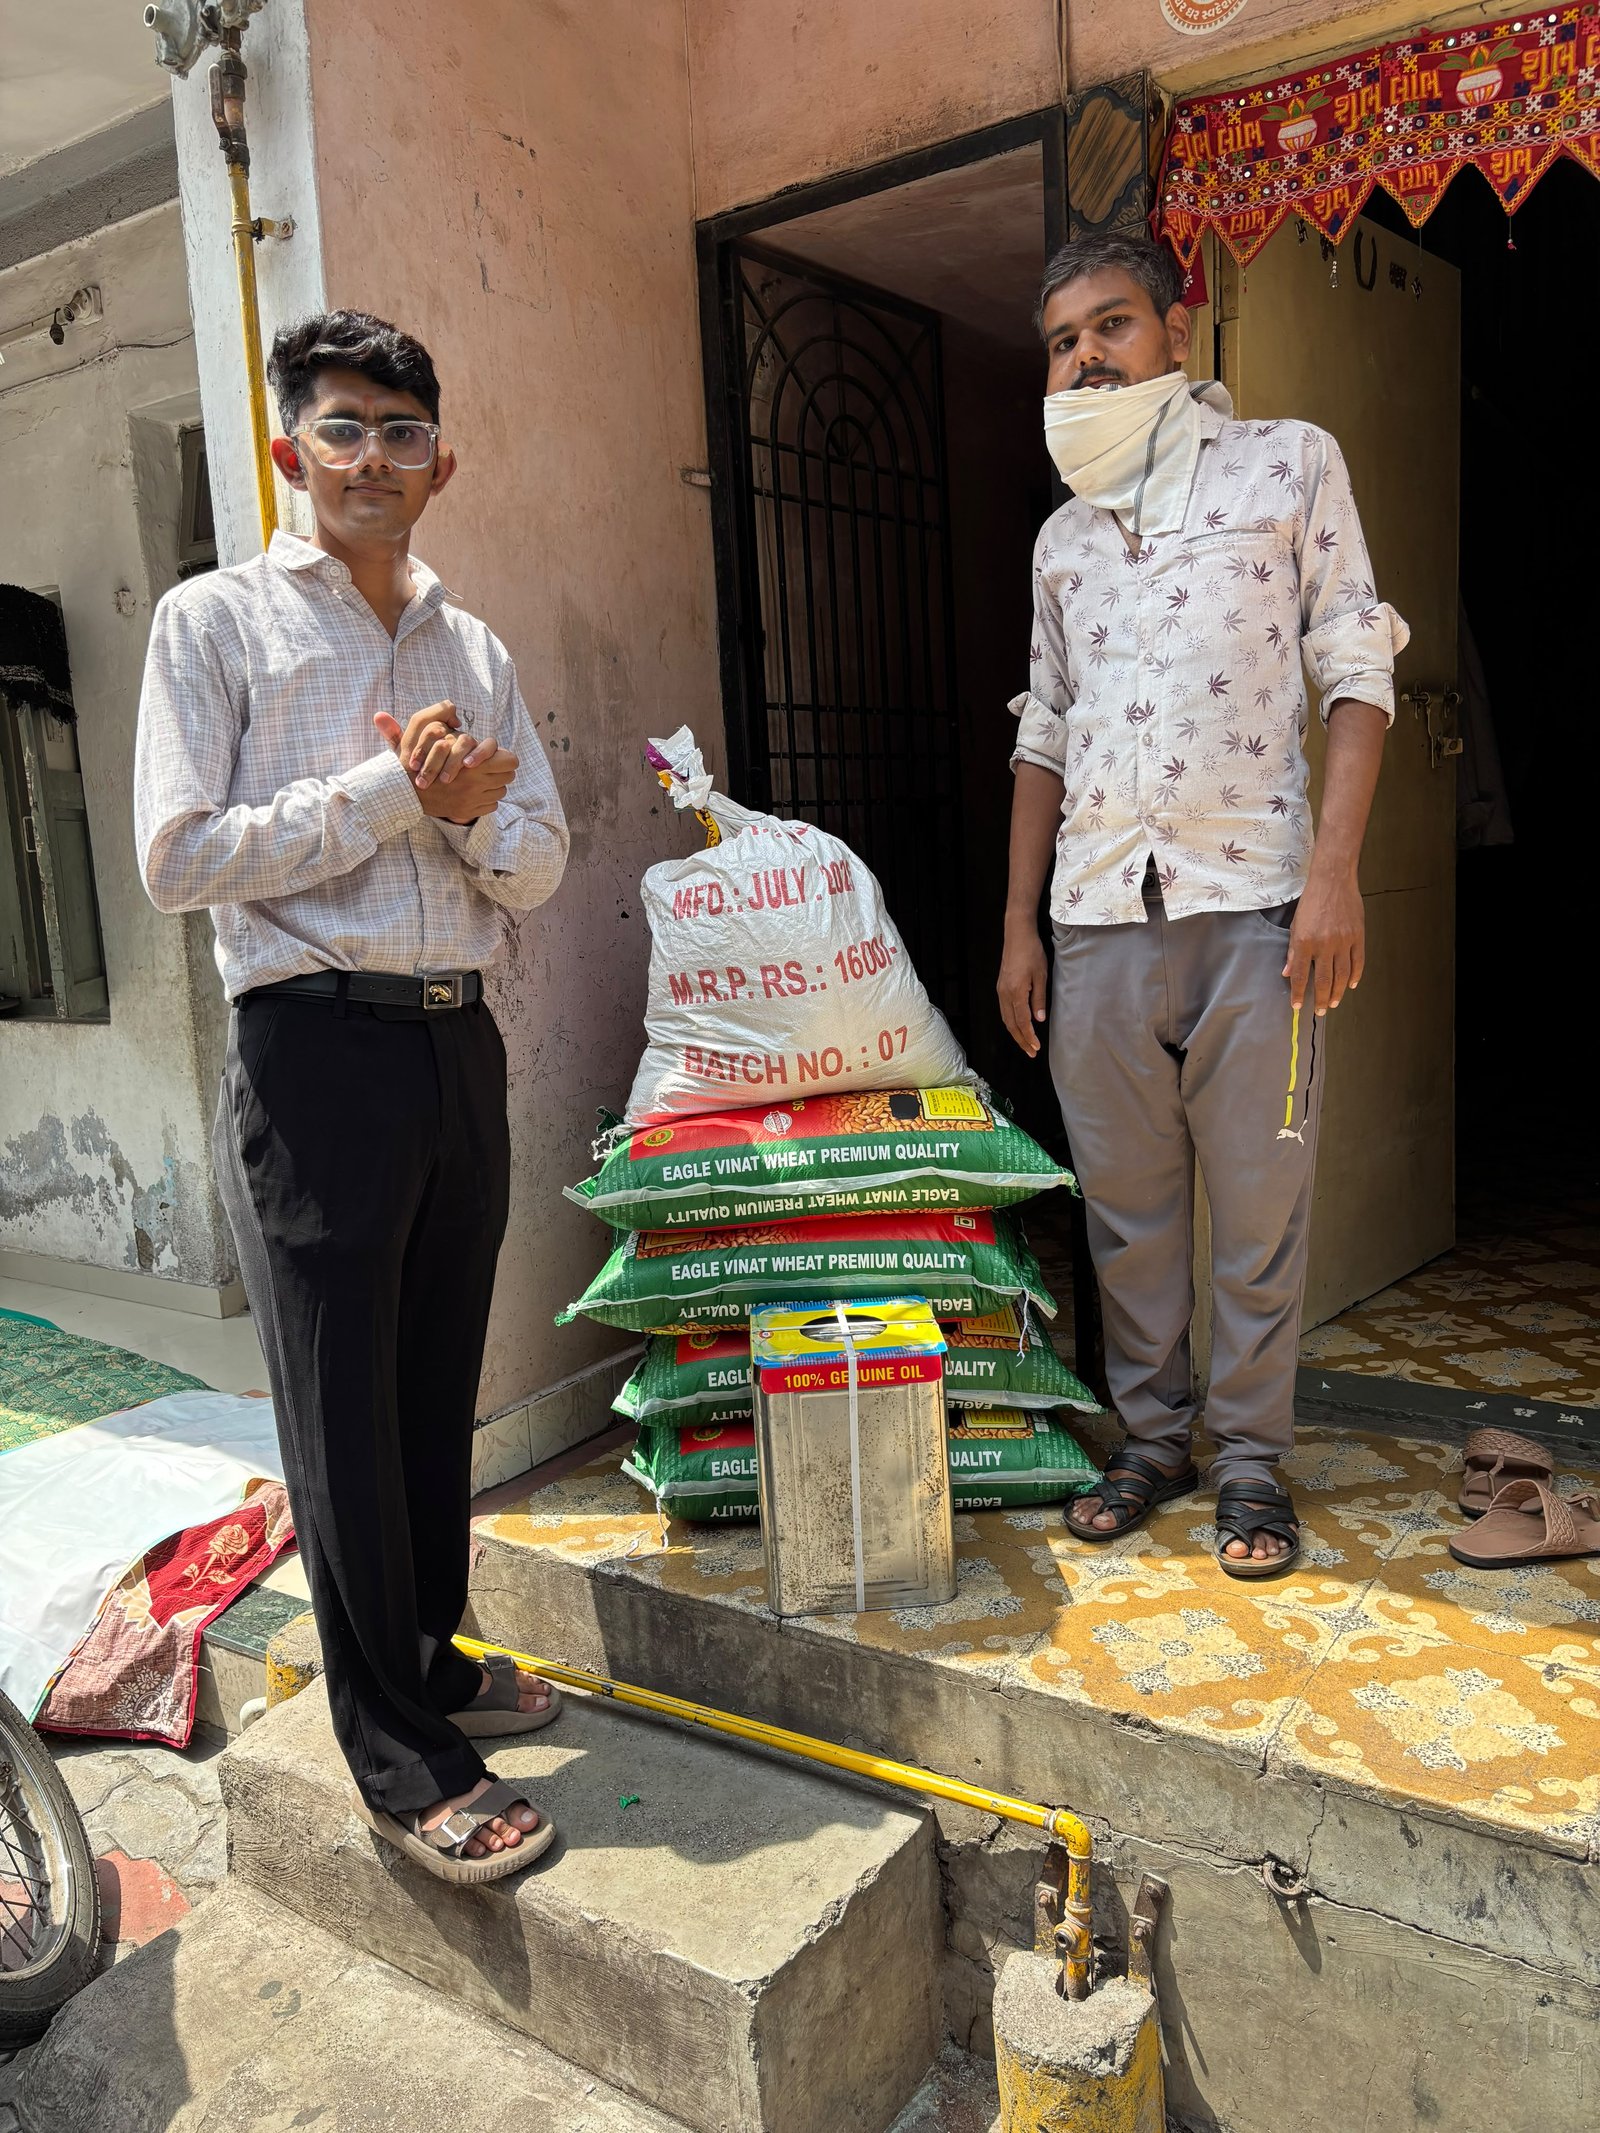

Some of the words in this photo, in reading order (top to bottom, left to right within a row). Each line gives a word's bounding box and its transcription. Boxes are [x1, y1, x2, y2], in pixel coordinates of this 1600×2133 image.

[748, 866, 806, 911] JULY
[668, 966, 754, 1006] M.R.P.
[684, 1045, 788, 1085] BATCH
[877, 1024, 909, 1062] 07
[662, 1161, 711, 1182] EAGLE
[714, 1155, 760, 1175] VINAT
[762, 1149, 819, 1170] WHEAT
[821, 1143, 891, 1164] PREMIUM
[895, 1142, 960, 1161] QUALITY
[807, 1192, 859, 1209] WHEAT
[862, 1188, 907, 1205] VINAT
[911, 1188, 960, 1201] EAGLE
[665, 1204, 730, 1224] QUALITY
[734, 1196, 804, 1217] PREMIUM
[671, 1261, 720, 1281] EAGLE
[723, 1257, 768, 1275] VINAT
[771, 1254, 824, 1272] WHEAT
[828, 1253, 898, 1270] PREMIUM
[902, 1252, 967, 1269] QUALITY
[679, 1306, 739, 1319] QUALITY
[784, 1372, 825, 1389] 100%
[830, 1366, 895, 1386] GEUINE
[900, 1365, 925, 1380] OIL
[945, 1361, 996, 1377] UALITY
[710, 1408, 753, 1421] ALITY
[950, 1450, 1002, 1467] UALITY
[711, 1459, 758, 1477] EAGLE
[955, 1496, 1002, 1508] EAGLE
[710, 1504, 760, 1518] UALITY
